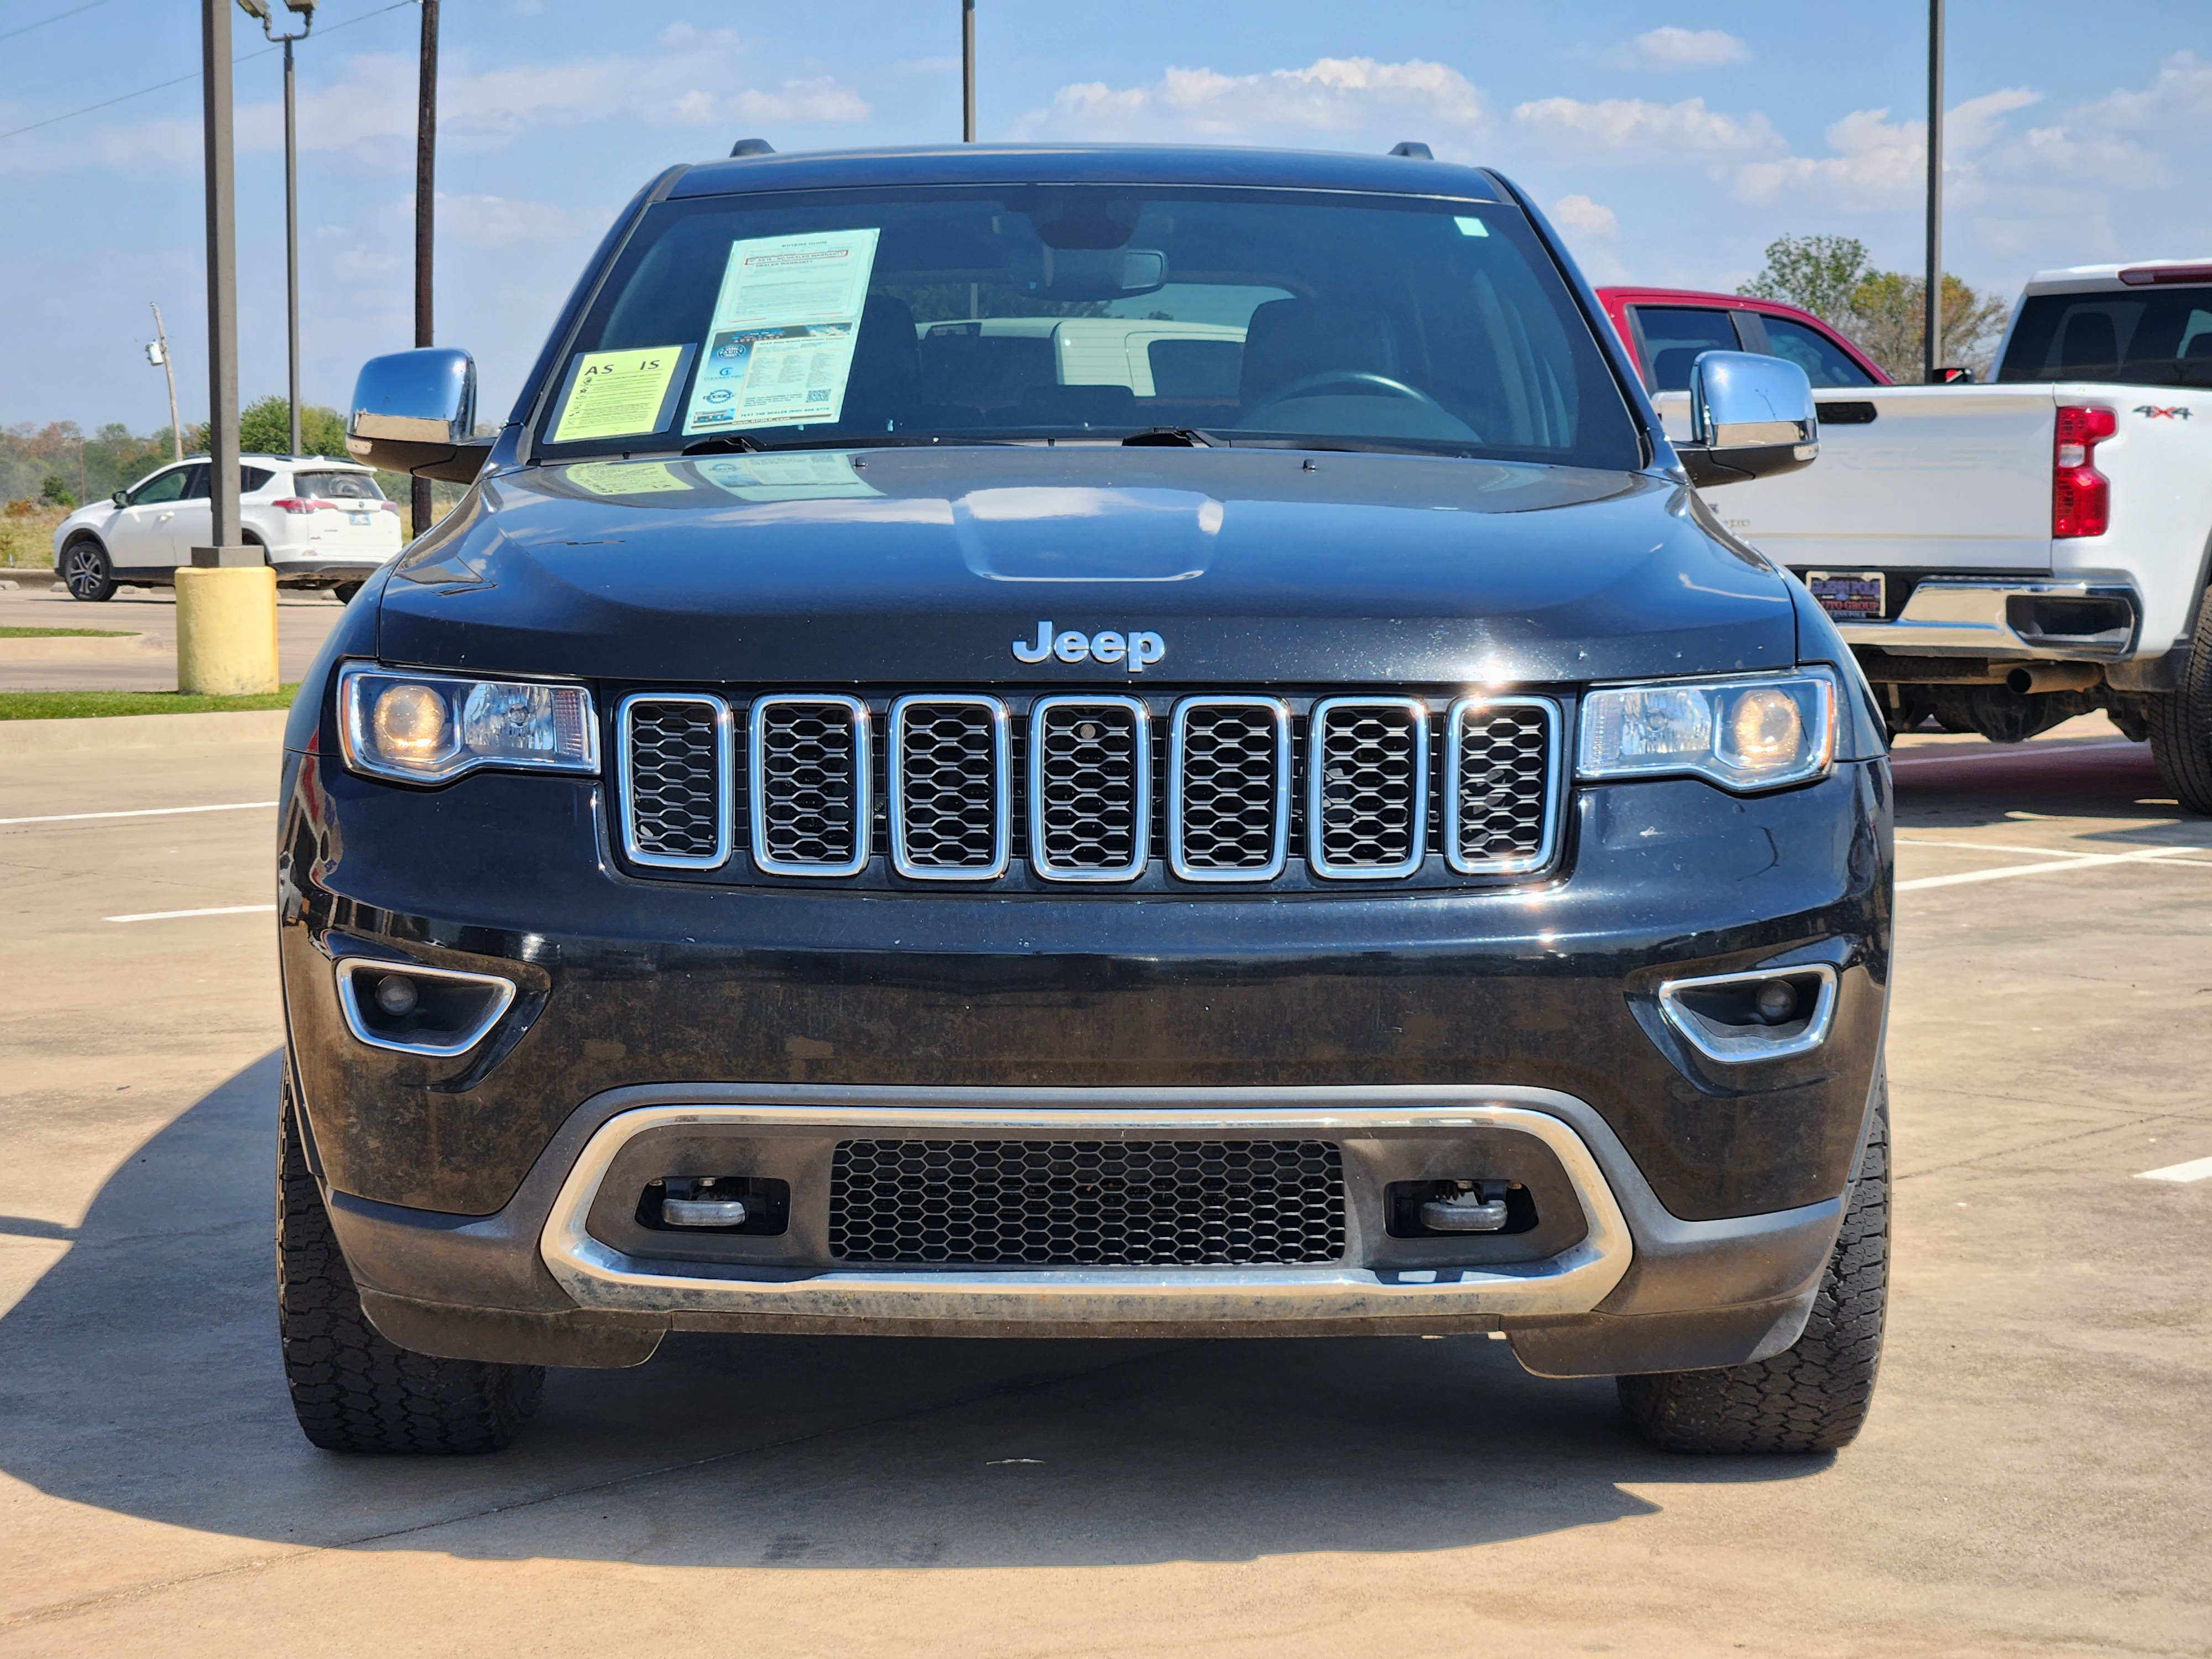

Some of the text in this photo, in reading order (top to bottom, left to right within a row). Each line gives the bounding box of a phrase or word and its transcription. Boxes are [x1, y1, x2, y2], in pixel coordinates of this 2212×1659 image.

[584, 359, 660, 376] AS IS
[1824, 446, 2022, 471] ROLET
[1844, 601, 1879, 611] GROUP
[1011, 620, 1165, 673] Jeep
